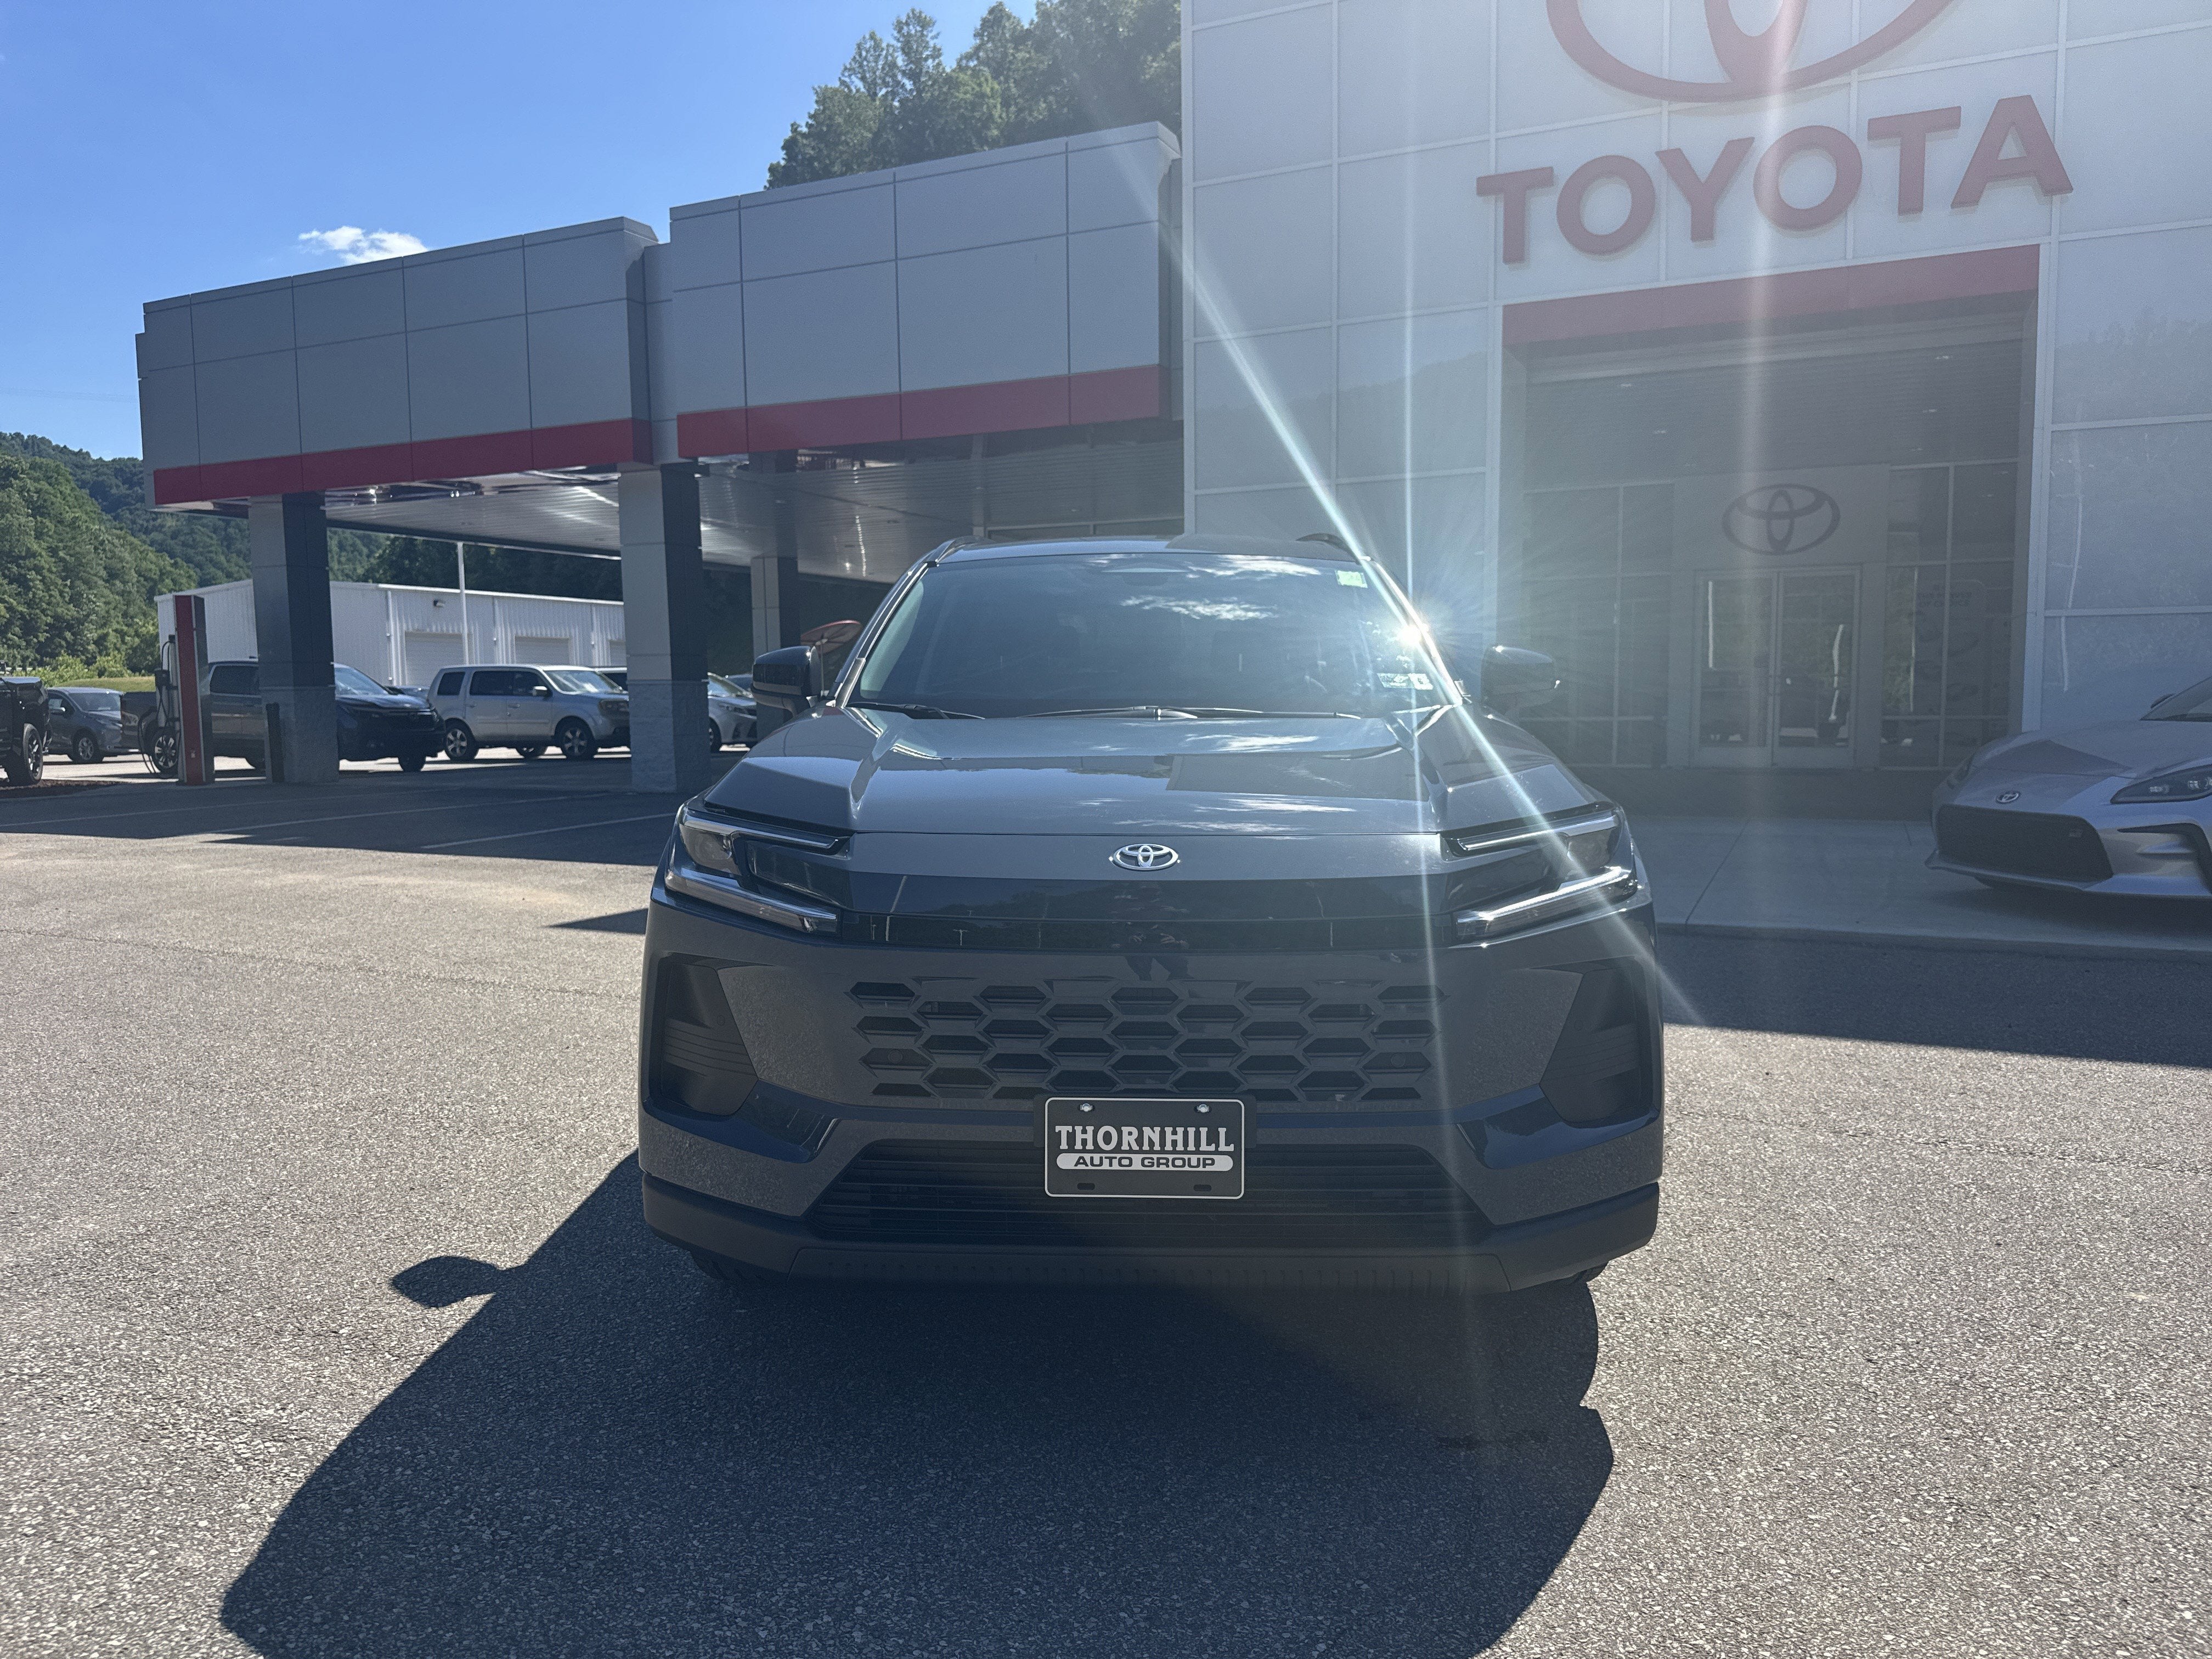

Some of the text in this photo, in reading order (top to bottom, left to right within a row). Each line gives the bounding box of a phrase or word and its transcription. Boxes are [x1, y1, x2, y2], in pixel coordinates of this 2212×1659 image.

[1476, 94, 2074, 264] TOYOTA
[1055, 1125, 1234, 1152] THORNHILL
[1074, 1156, 1216, 1169] AUTO GROUP
